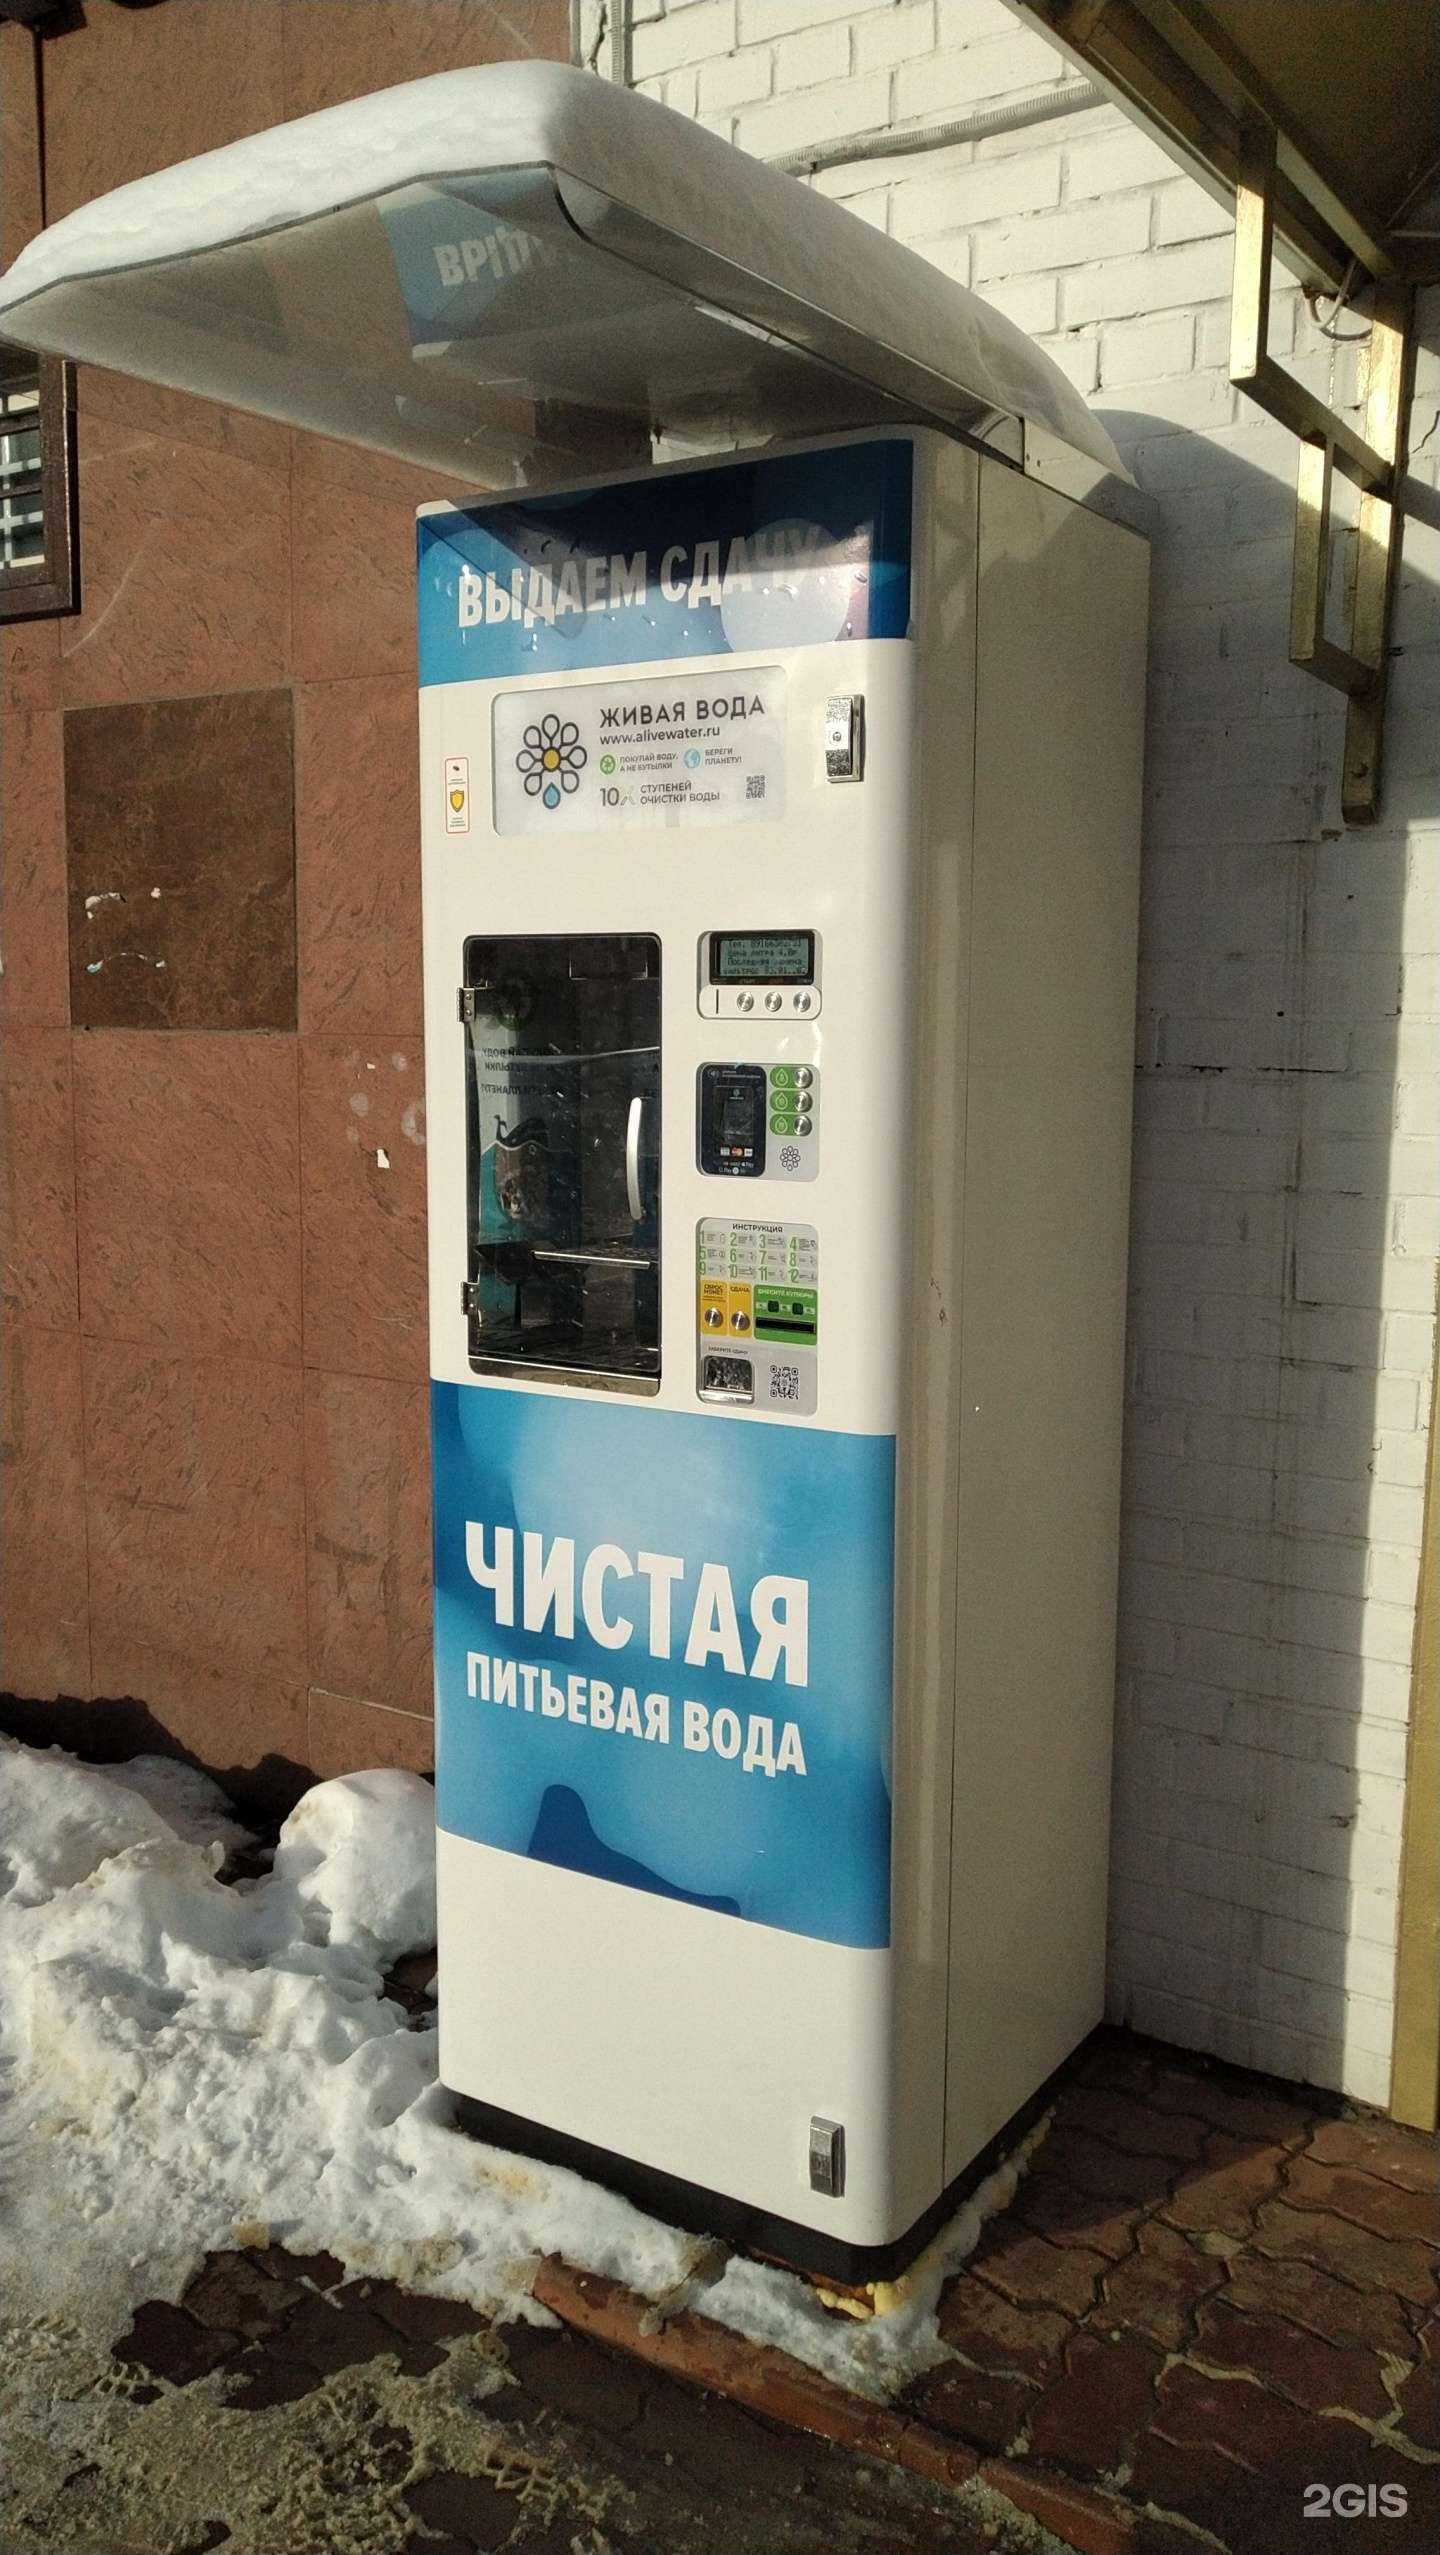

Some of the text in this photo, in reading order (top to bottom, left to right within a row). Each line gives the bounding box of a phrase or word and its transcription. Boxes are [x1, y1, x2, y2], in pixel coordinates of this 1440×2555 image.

[458, 550, 648, 628] ВЫДАЕМ
[600, 695, 766, 729] ЖИВАЯ ВОДА
[600, 726, 721, 746] www.alivewater.ru
[705, 746, 734, 757] БЕРЕГИ
[619, 761, 673, 773] А НЕ БУТЫЛКИ
[640, 780, 693, 794] СТУПЕНЕЙ
[640, 790, 721, 806] ОЧИСТКИ ВОДЫ
[732, 1223, 784, 1233] ИНСТРУКЦИЯ
[729, 1232, 738, 1247] 2
[758, 1234, 767, 1249] 3
[789, 1236, 798, 1251] 4
[729, 1248, 737, 1263] 6
[758, 1250, 767, 1265] 7
[789, 1252, 797, 1267] 8
[728, 1264, 738, 1279] 10
[758, 1267, 768, 1281] 11
[788, 1268, 800, 1283] 12
[465, 1520, 809, 1687] ЧИСТАЯ
[466, 1651, 808, 1778] ПИТЬЕВАЯ ВОДА
